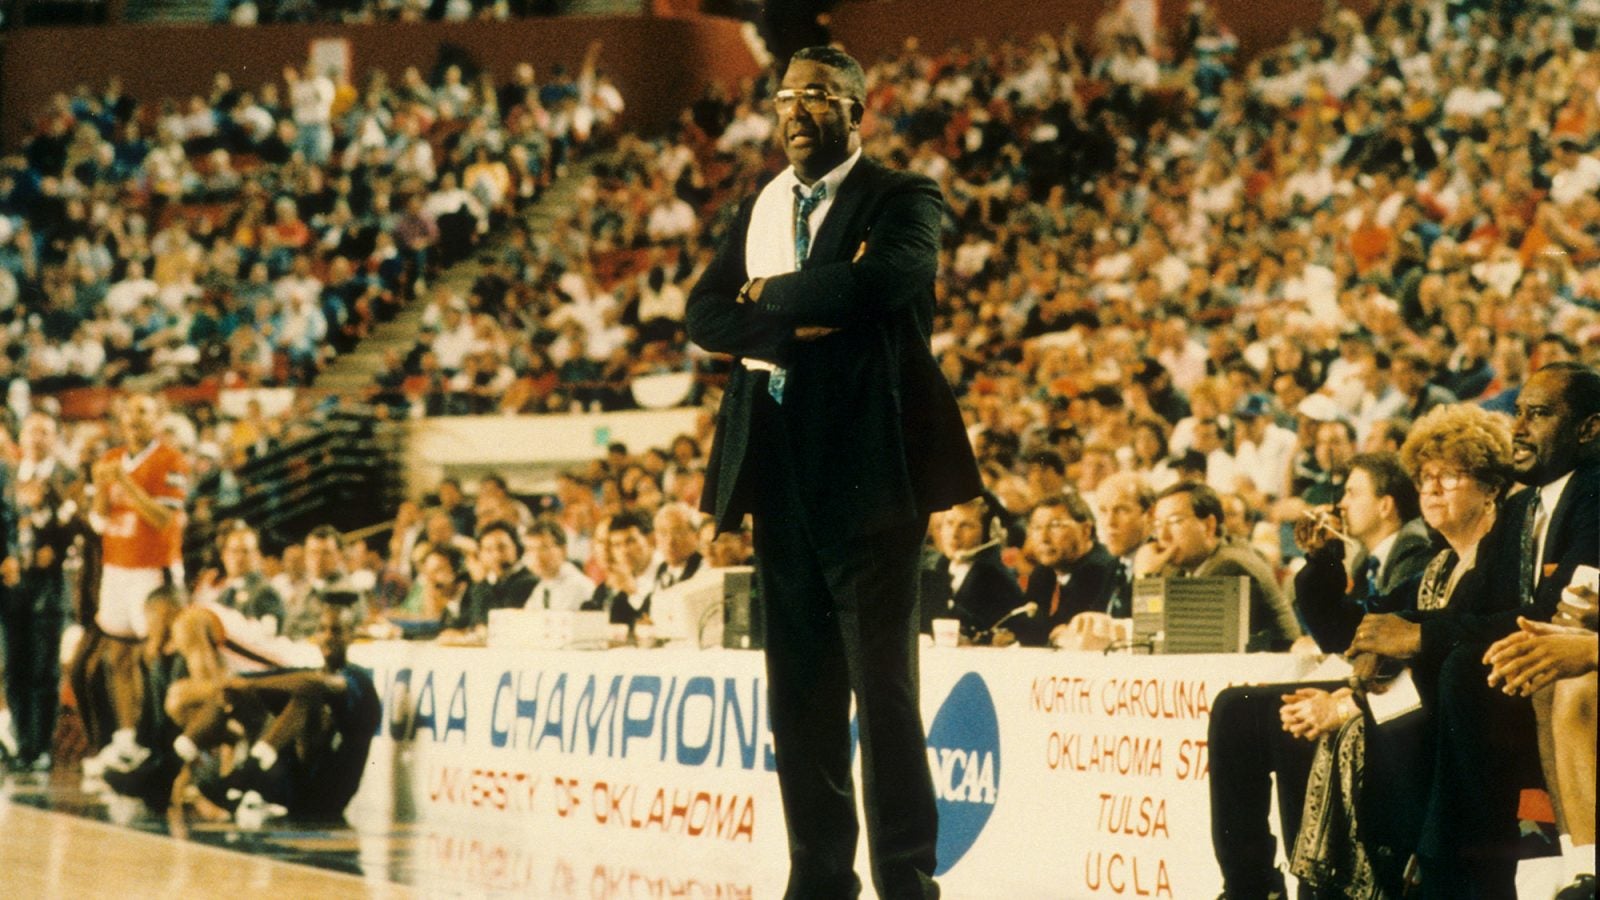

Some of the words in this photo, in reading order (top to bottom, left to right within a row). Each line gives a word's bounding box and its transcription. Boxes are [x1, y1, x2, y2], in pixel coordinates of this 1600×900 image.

[1031, 676, 1094, 714] NORTH
[1101, 679, 1210, 719] CAROLINA
[1047, 732, 1162, 776] OKLAHOMA
[1176, 739, 1209, 780] ST
[554, 777, 580, 817] OF
[593, 781, 755, 843] OKLAHOMA
[1097, 794, 1169, 839] TULSA
[1085, 853, 1173, 899] UCLA
